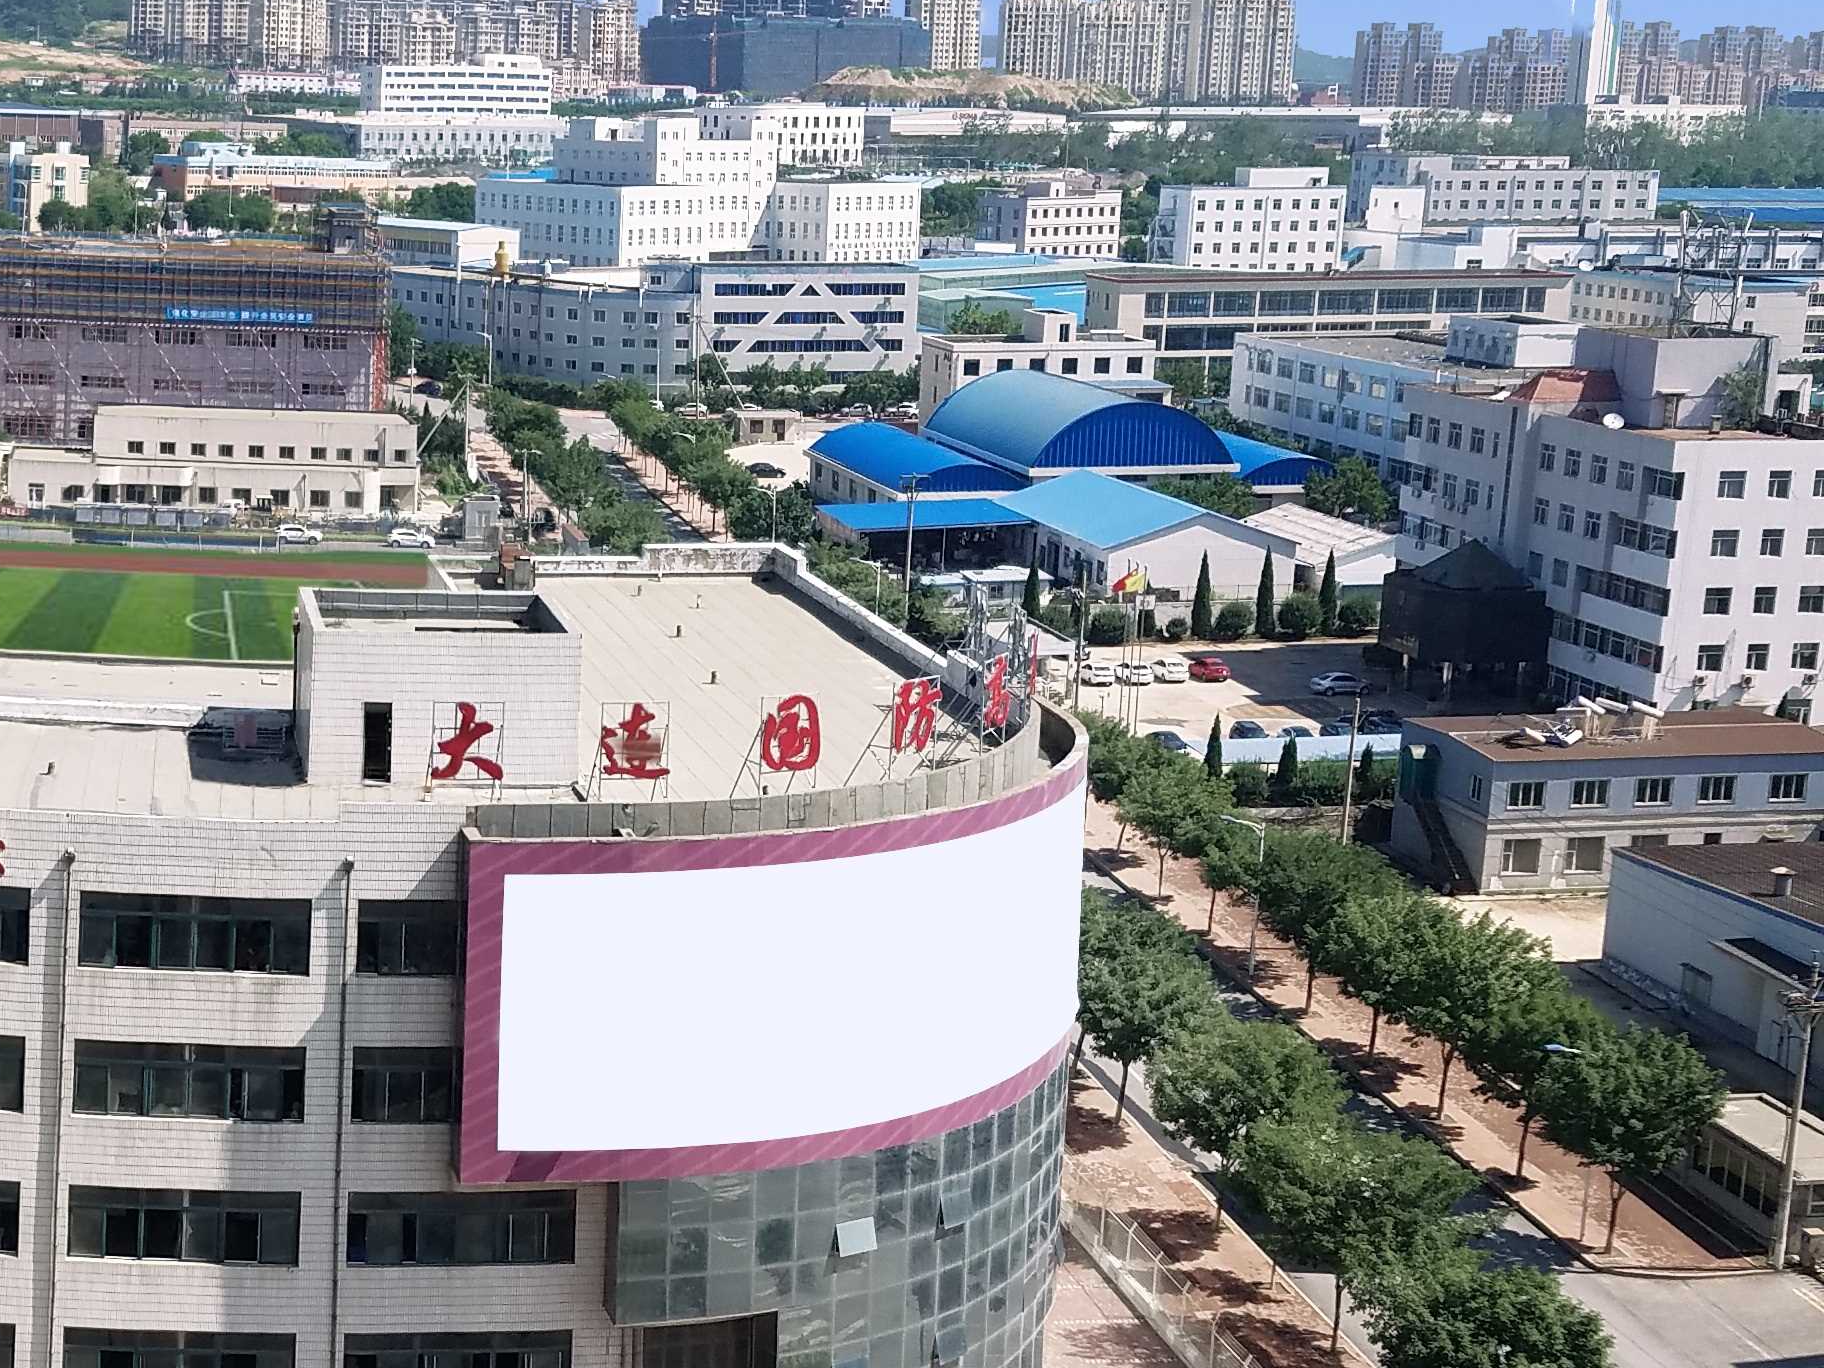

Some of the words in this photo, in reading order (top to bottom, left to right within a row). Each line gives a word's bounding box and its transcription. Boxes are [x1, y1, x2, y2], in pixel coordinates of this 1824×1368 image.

[431, 633, 1039, 781] 大连国防高
